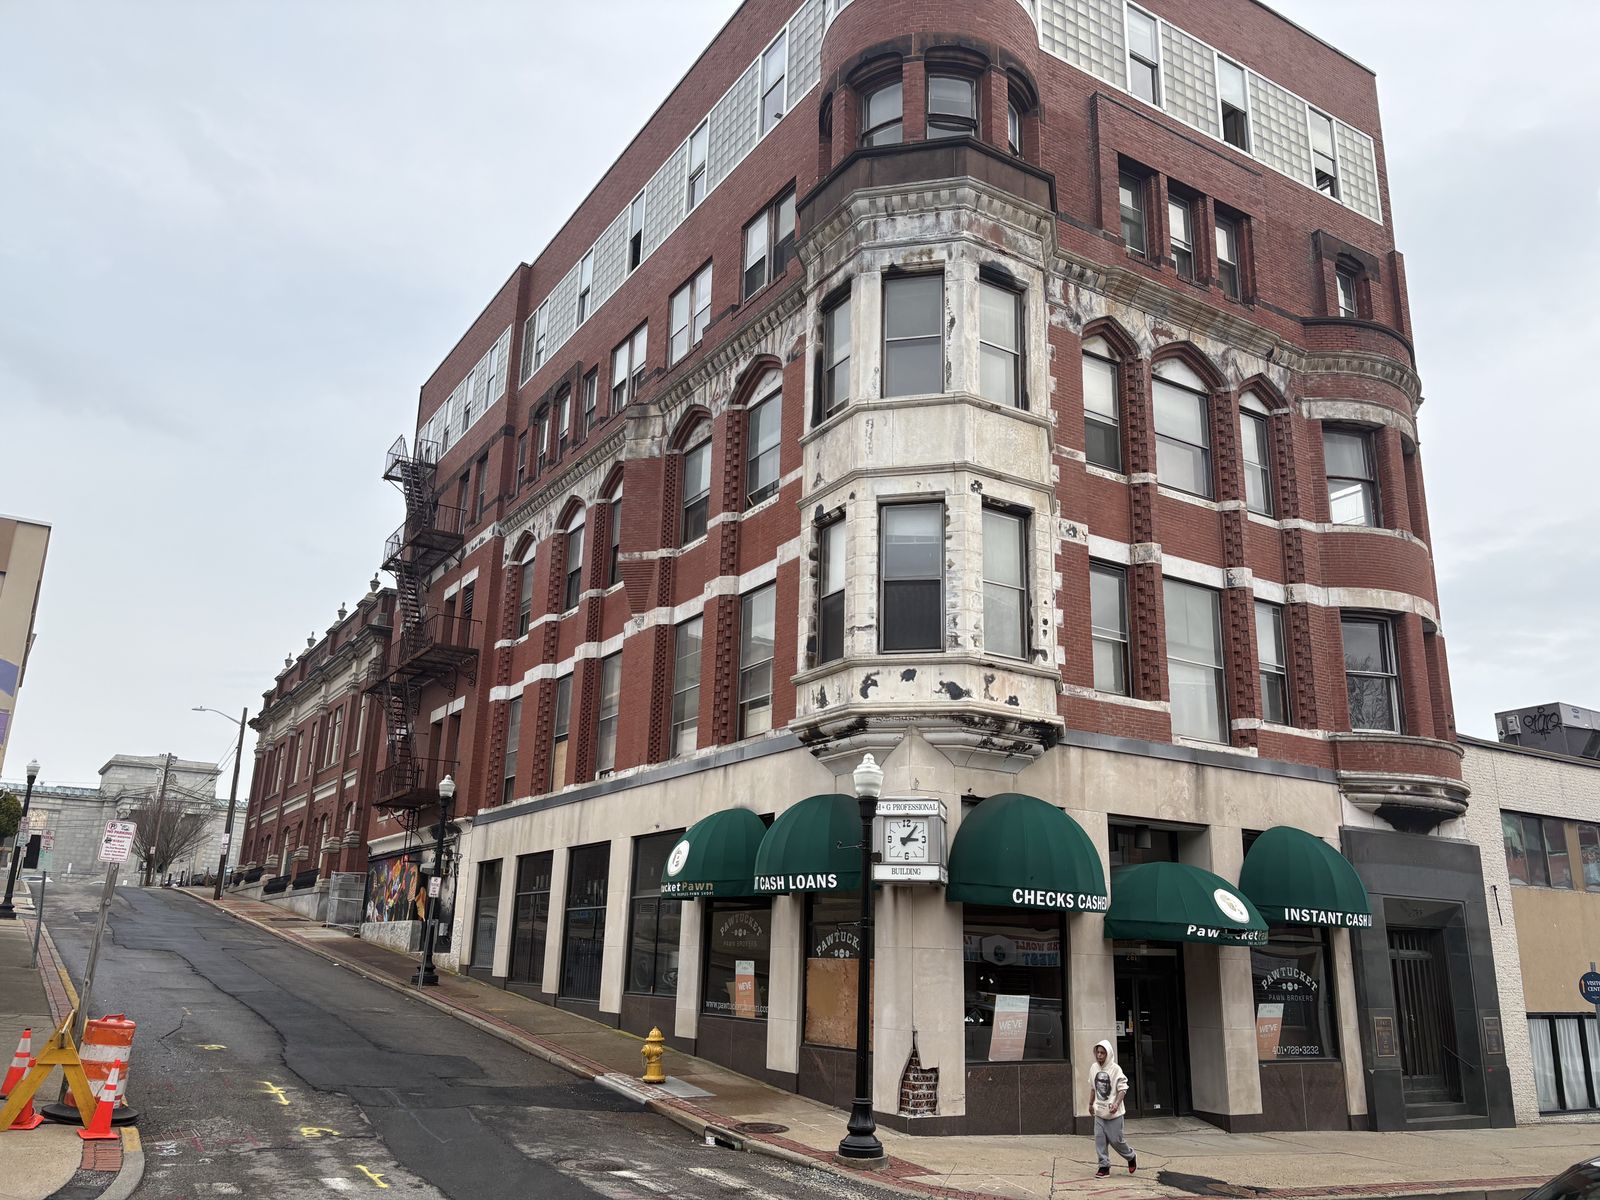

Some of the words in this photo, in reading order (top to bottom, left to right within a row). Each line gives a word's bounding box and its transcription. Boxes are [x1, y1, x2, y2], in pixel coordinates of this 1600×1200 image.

[902, 819, 911, 828] 12
[887, 835, 893, 844] 9
[921, 836, 927, 844] 3
[904, 852, 910, 860] 6
[682, 881, 714, 891] Pawn
[760, 875, 785, 891] CASH
[789, 873, 838, 890] LOANS
[1012, 888, 1075, 909] CHECKS
[1077, 894, 1107, 911] CASHED
[720, 913, 763, 937] PAWTUCKET
[1284, 907, 1343, 925] INSTANT
[1346, 913, 1368, 927] CASH
[816, 931, 860, 957] PAWTUCK
[1261, 966, 1318, 992] PAWTUCKET
